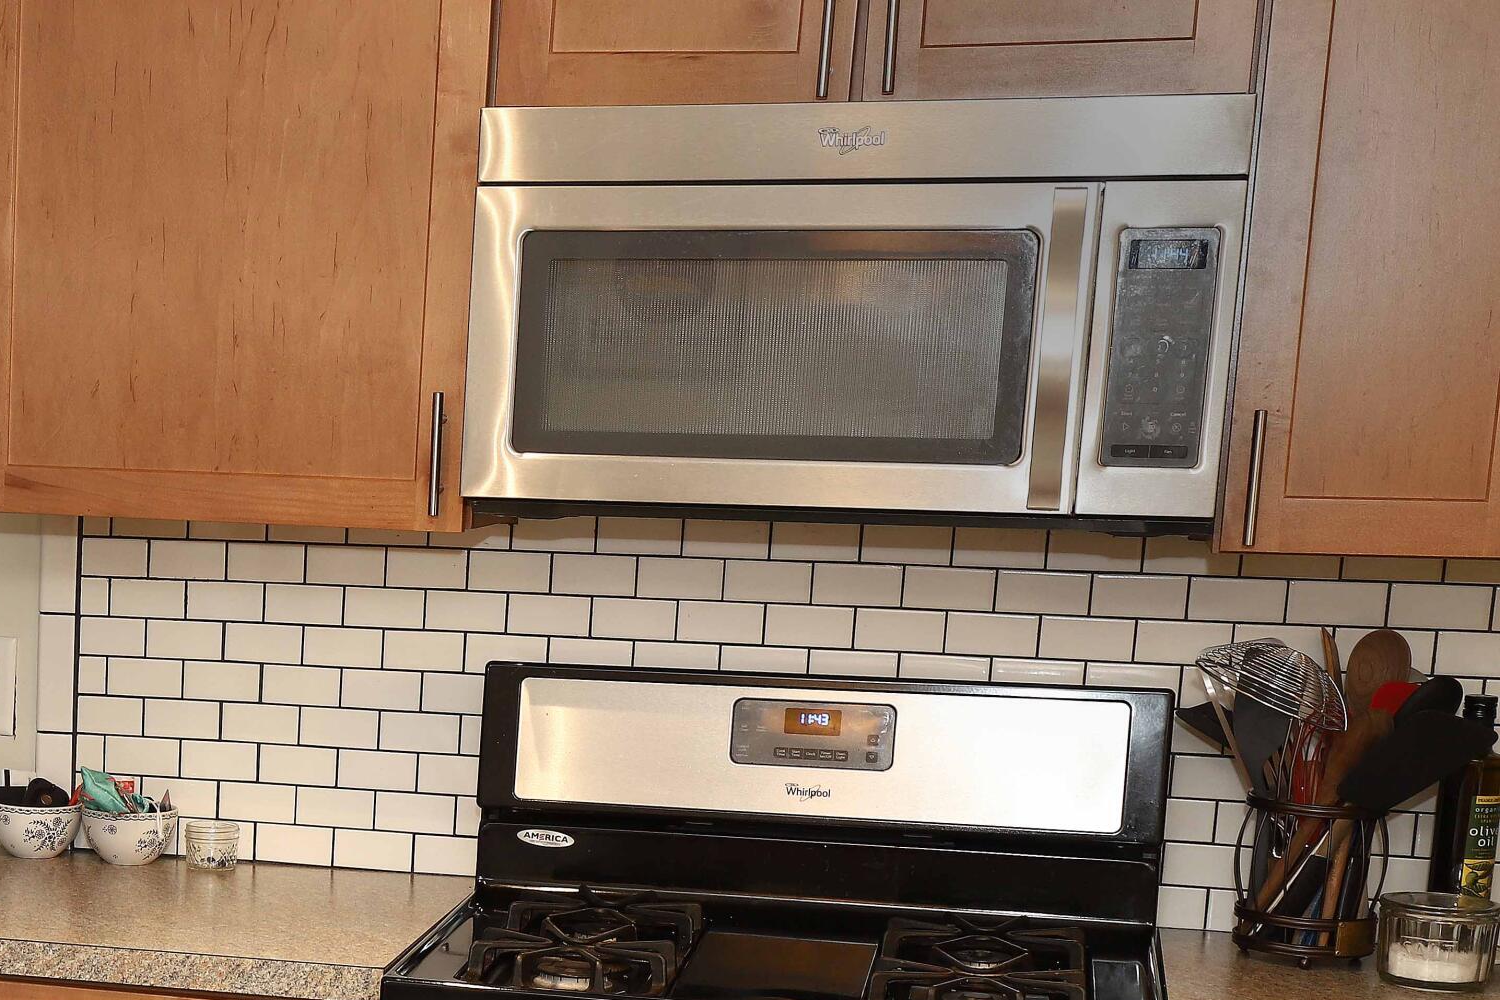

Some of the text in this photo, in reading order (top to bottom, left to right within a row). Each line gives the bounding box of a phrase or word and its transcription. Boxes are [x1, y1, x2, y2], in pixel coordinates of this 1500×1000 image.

[819, 128, 886, 153] Whirlpool
[799, 712, 831, 726] 11:43
[784, 784, 831, 800] Whirlpool
[523, 831, 569, 843] AMERICA
[1477, 836, 1495, 847] oil
